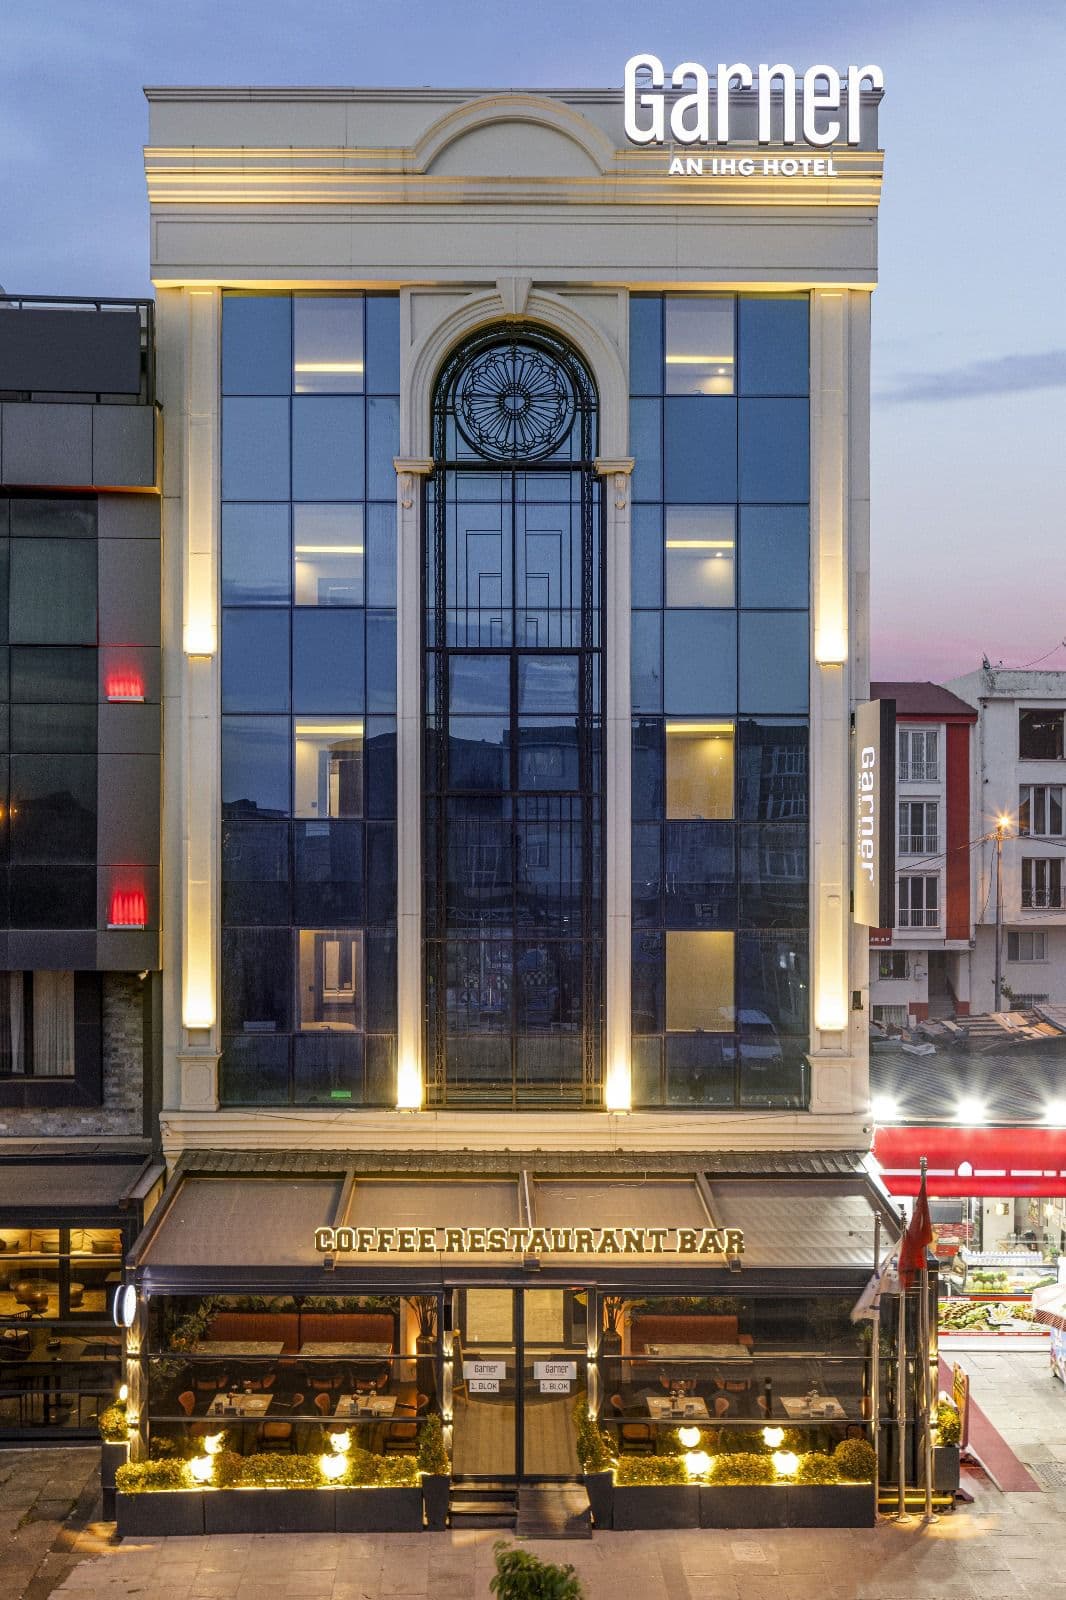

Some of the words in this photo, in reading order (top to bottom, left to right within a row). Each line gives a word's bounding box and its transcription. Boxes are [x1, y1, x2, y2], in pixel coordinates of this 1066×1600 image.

[624, 54, 884, 147] Garner
[669, 158, 704, 176] AN
[712, 158, 755, 177] IHG
[763, 159, 838, 177] HOTEL
[861, 746, 875, 882] Garner
[314, 1227, 437, 1253] COFFEE
[445, 1228, 669, 1253] RESTAURANT
[677, 1228, 746, 1253] BAR
[474, 1365, 498, 1373] Garner
[545, 1365, 569, 1374] Garner
[478, 1382, 498, 1390] BLOK
[549, 1382, 569, 1390] BLOK
